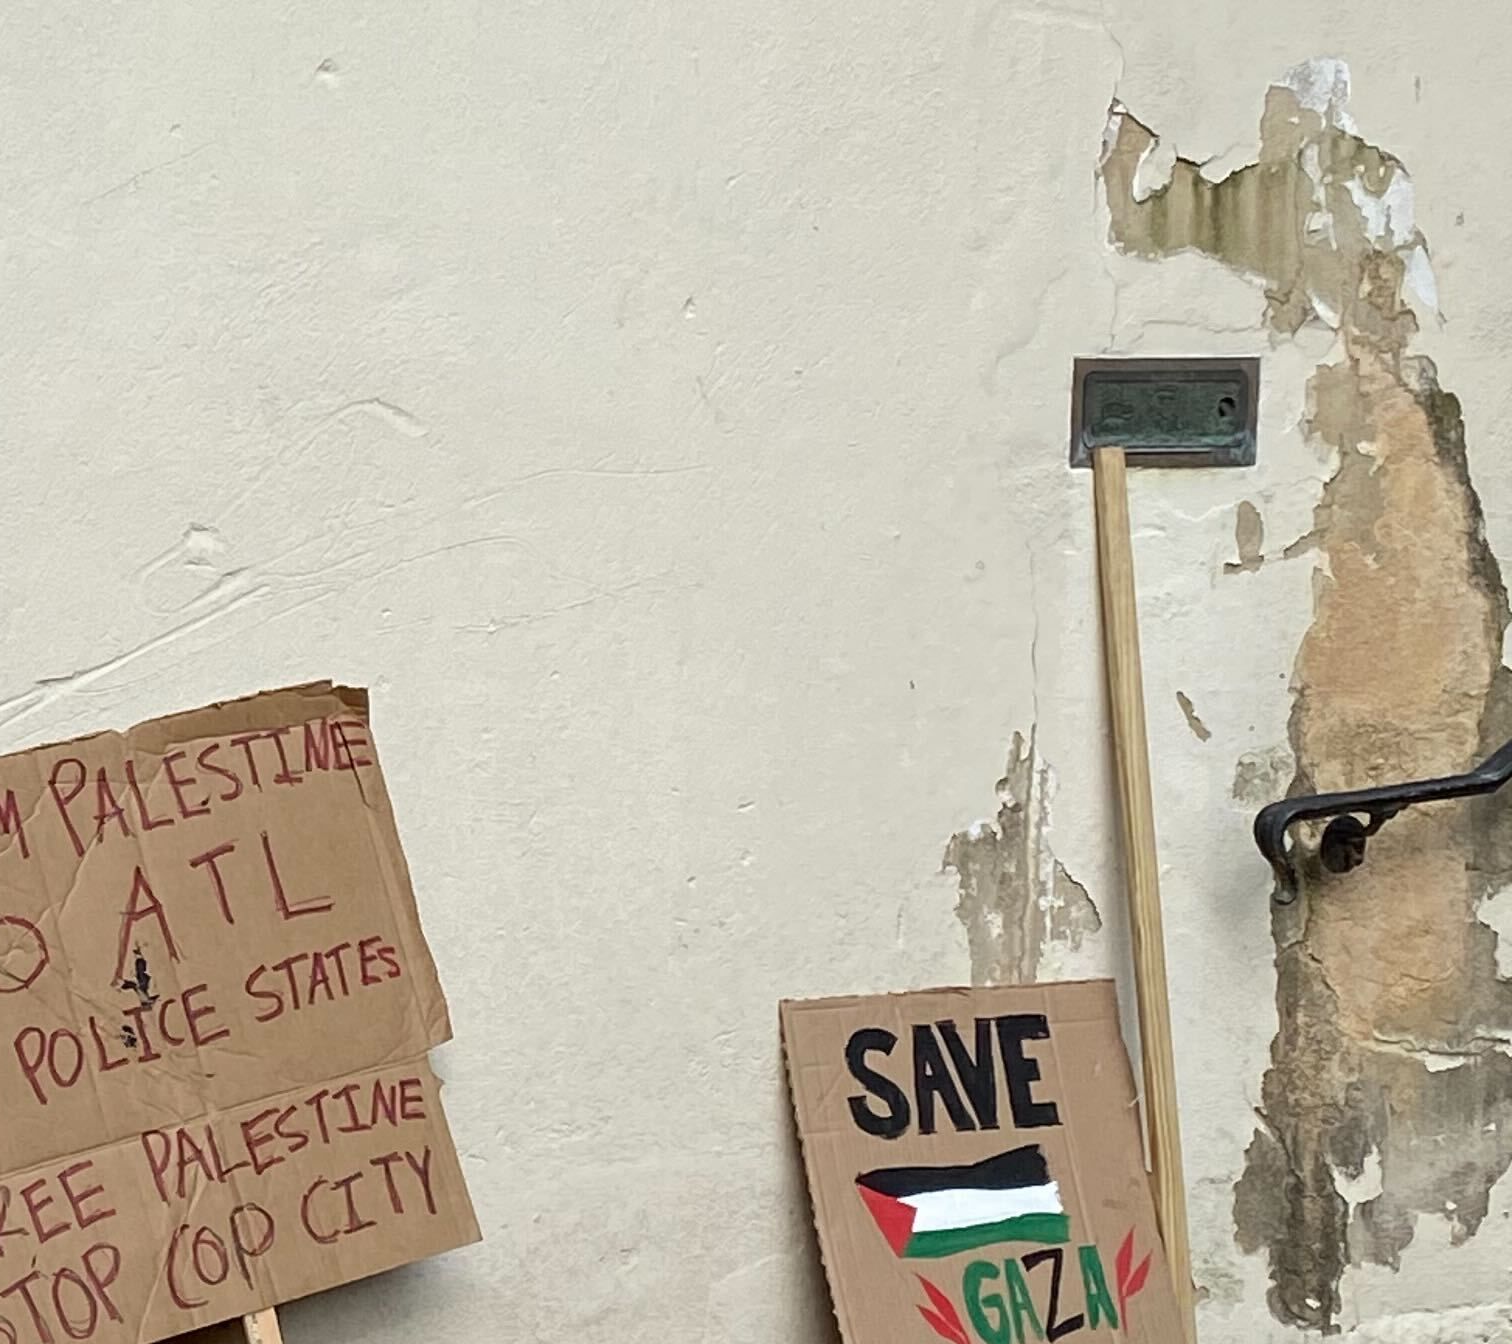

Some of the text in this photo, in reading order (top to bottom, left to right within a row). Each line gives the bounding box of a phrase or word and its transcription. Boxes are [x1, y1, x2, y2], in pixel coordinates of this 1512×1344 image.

[49, 719, 373, 856] PALESTINE
[111, 831, 335, 986] ATL
[14, 986, 229, 1104] POLICE
[247, 937, 402, 1022] STATES
[845, 1014, 1062, 1139] SAVE
[142, 1078, 426, 1203] PALESTINE
[168, 1203, 274, 1309] COP
[301, 1148, 437, 1244] CITY
